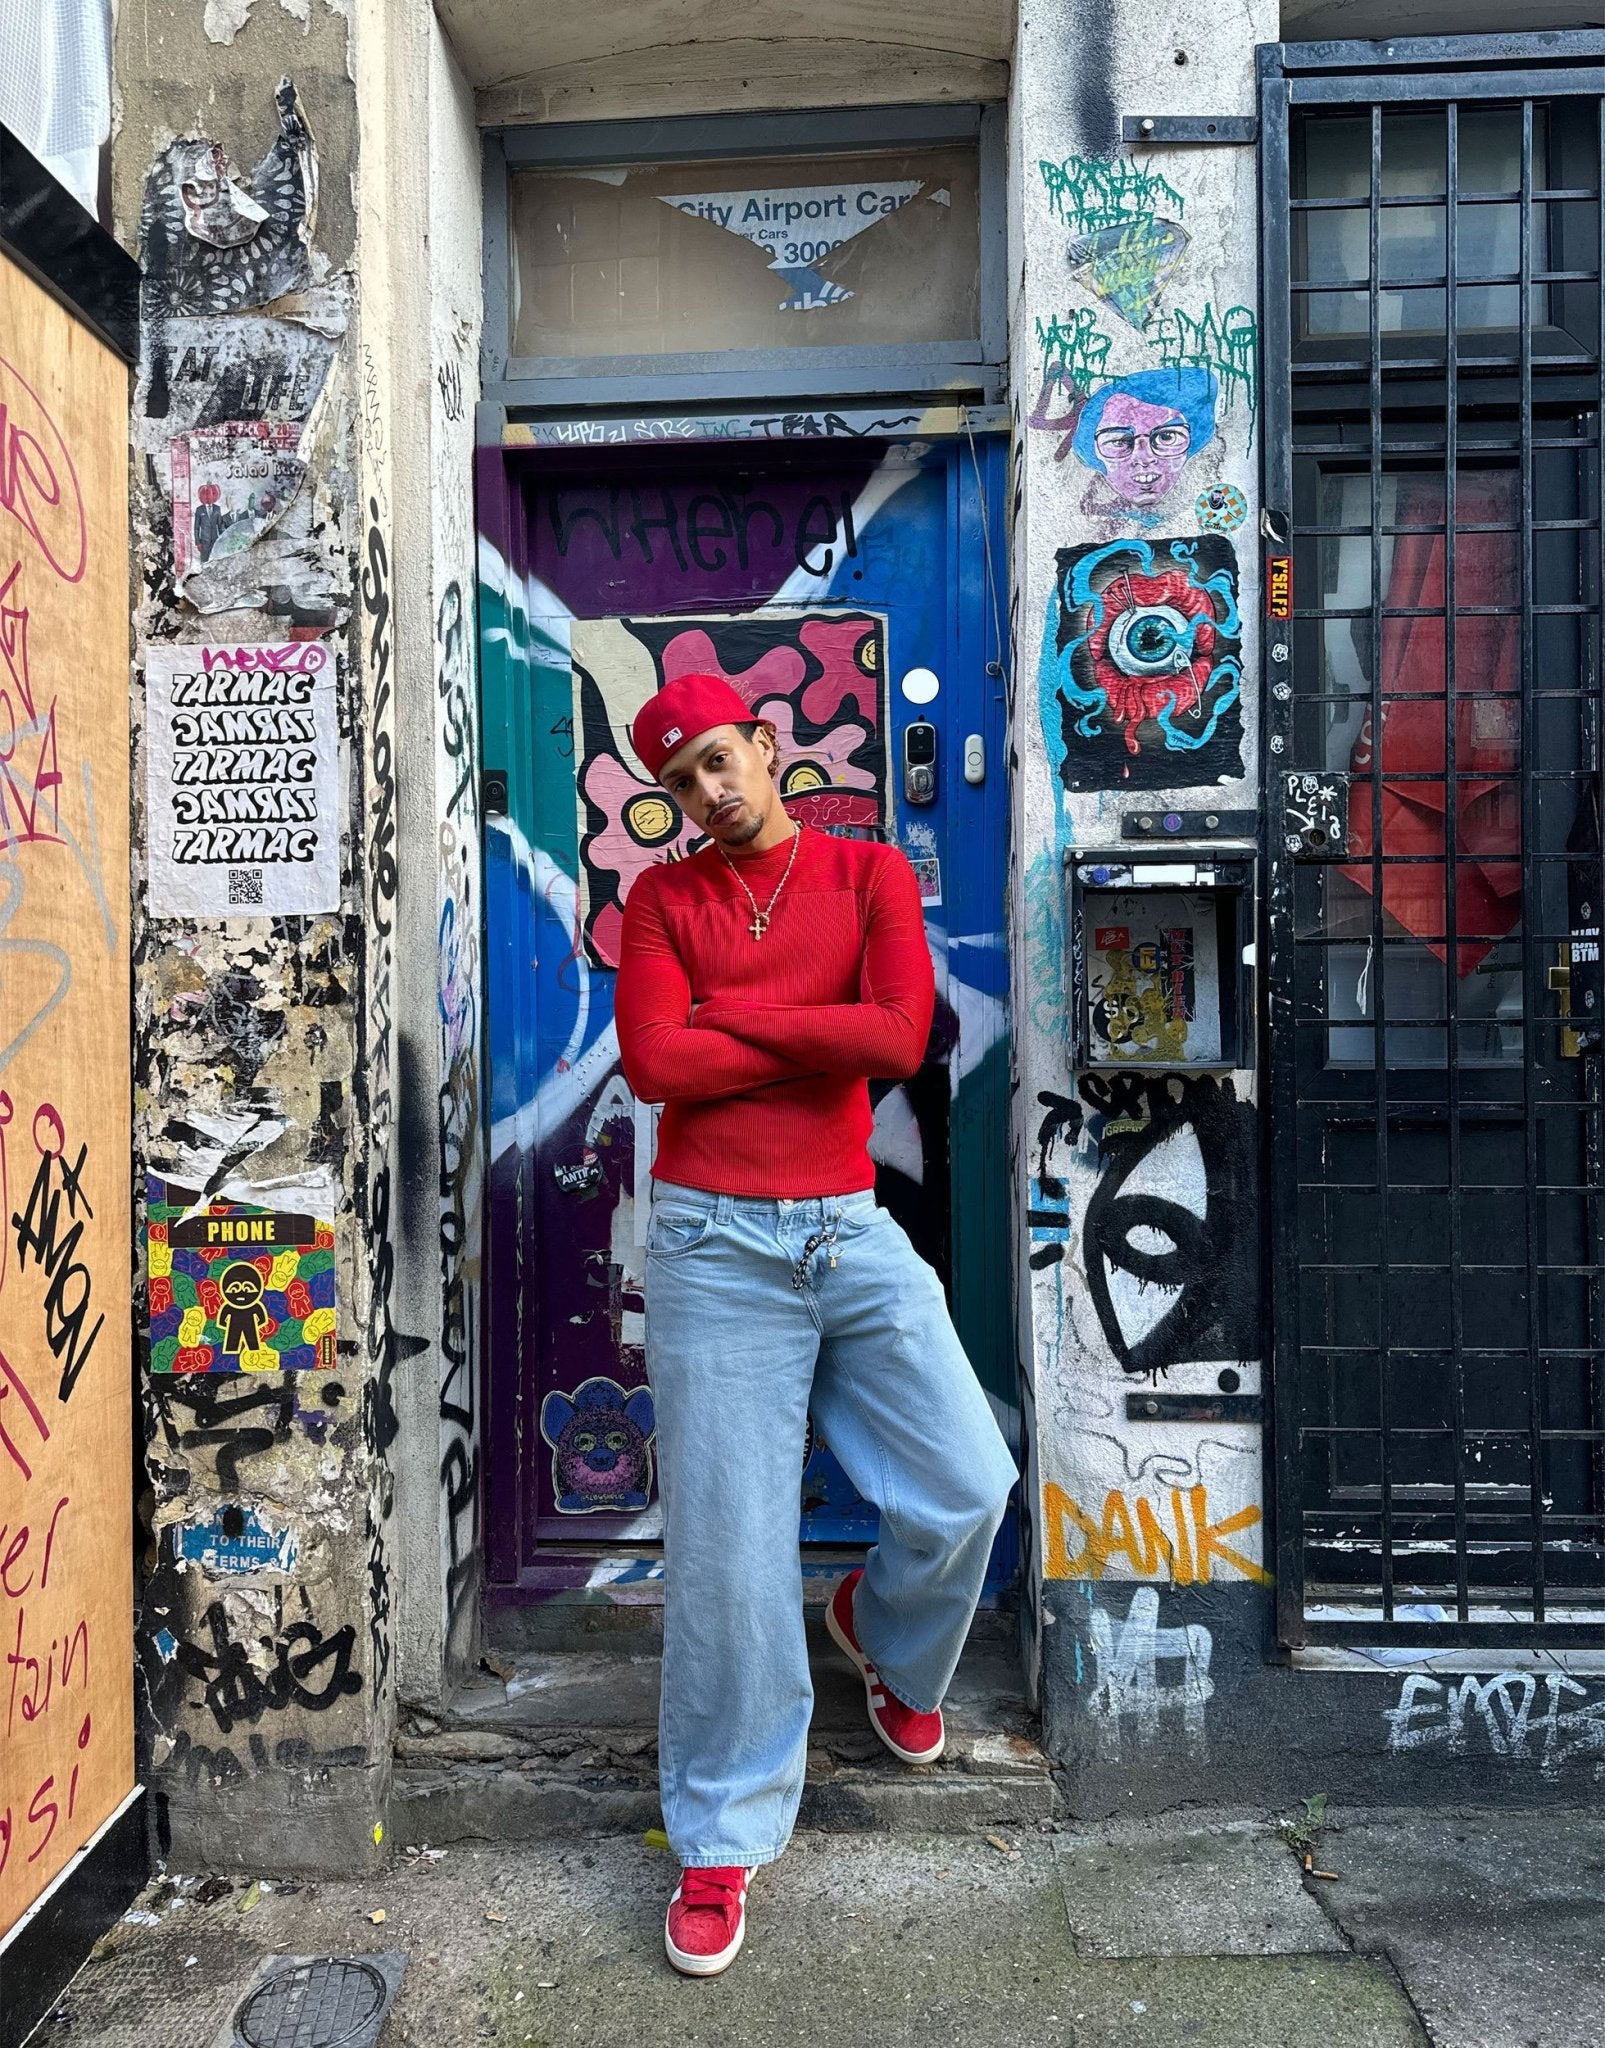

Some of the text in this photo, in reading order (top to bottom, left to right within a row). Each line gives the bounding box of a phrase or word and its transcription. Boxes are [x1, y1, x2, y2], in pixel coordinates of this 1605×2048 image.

[742, 194, 847, 226] Airport
[758, 228, 789, 241] Cars
[239, 374, 310, 411] LIFE
[225, 462, 270, 479] Salad
[1272, 559, 1289, 617] Y'SELF?
[171, 670, 316, 707] TARMAC
[172, 748, 317, 785] TARMAC
[172, 827, 319, 864] TARMAC
[1571, 947, 1600, 963] BTM
[207, 1220, 276, 1243] PHONE
[210, 1534, 280, 1549] TO THEIR
[1042, 1480, 1274, 1586] DANK
